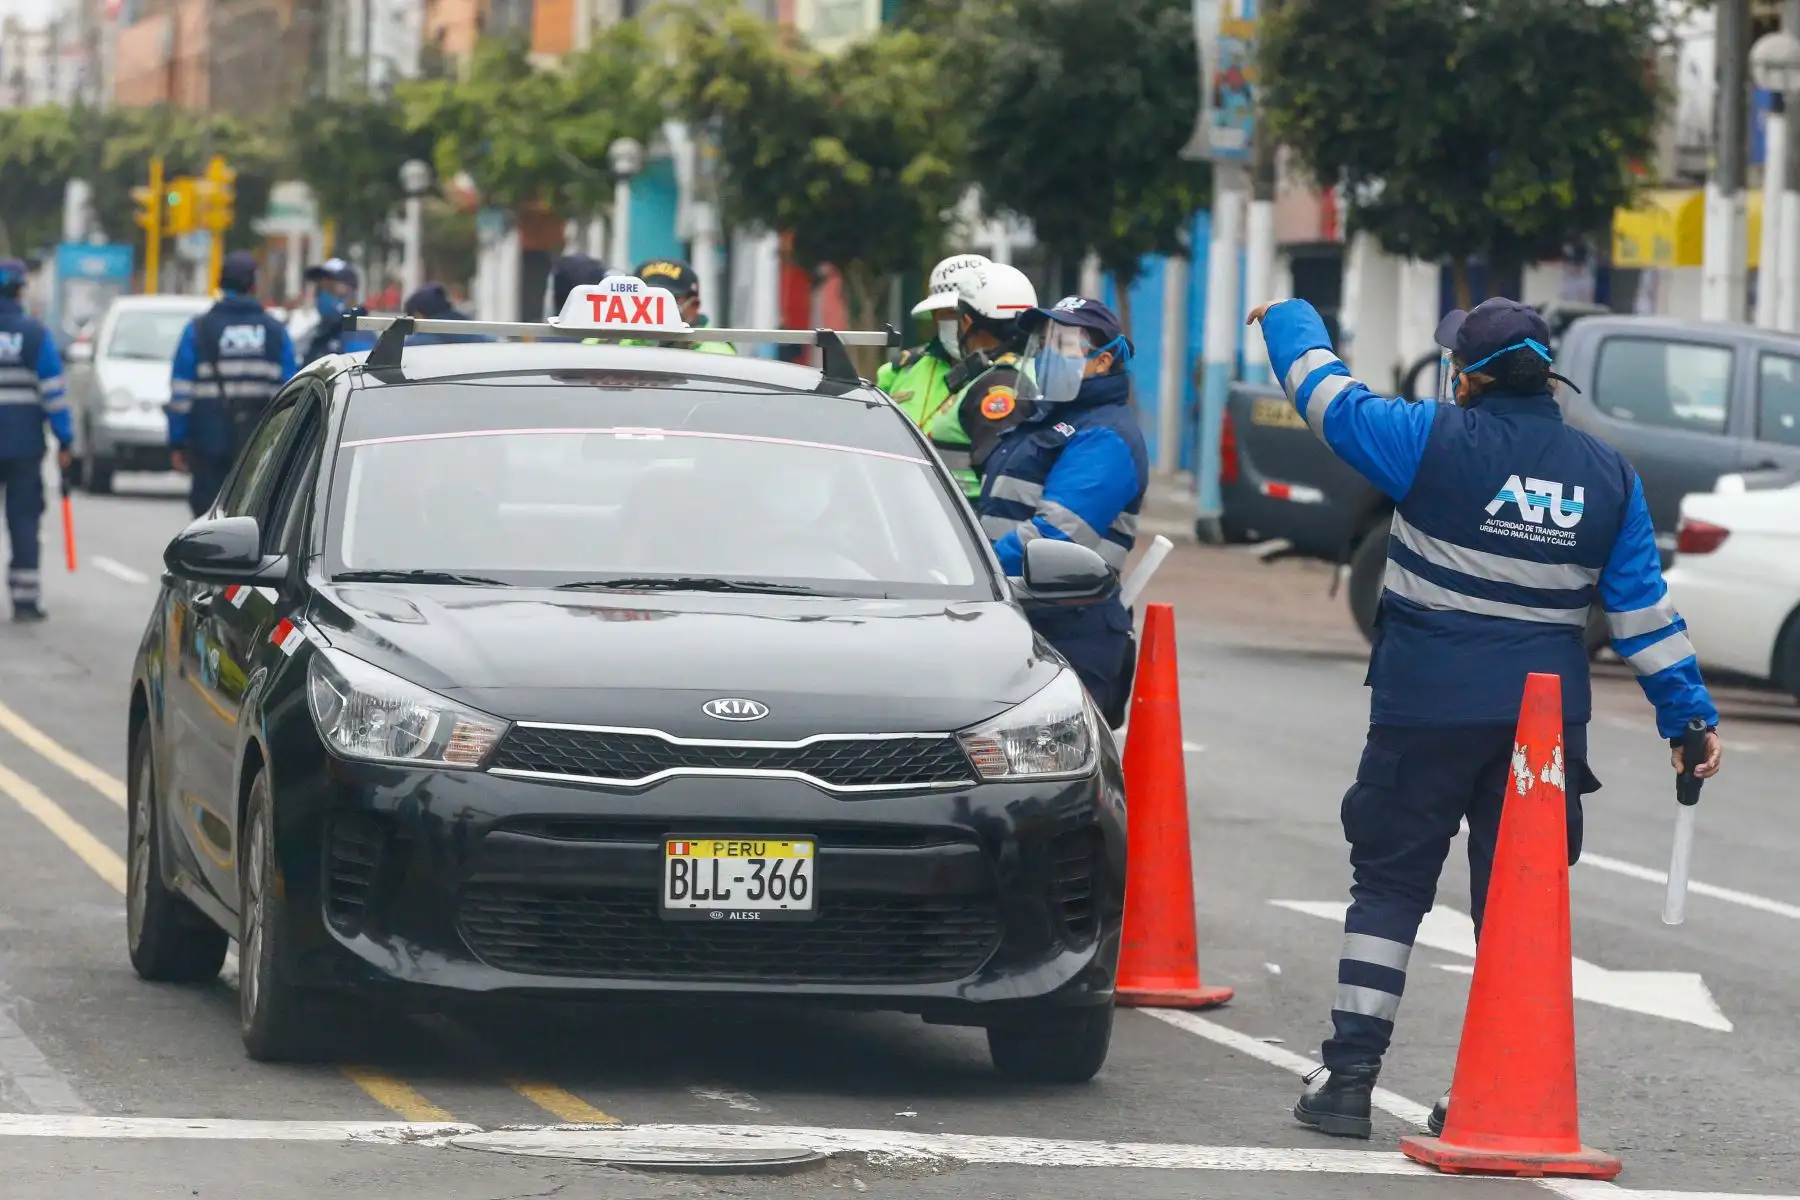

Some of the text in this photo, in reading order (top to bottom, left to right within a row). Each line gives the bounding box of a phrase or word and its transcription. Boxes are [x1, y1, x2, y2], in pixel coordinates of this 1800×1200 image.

[610, 283, 639, 293] LIBRE
[586, 294, 664, 325] TAXI
[1484, 474, 1585, 528] ATU
[1479, 524, 1510, 536] URBANO
[1510, 529, 1529, 540] PARA
[1529, 533, 1546, 543] LIMA
[1551, 537, 1577, 547] CALLAO
[1485, 518, 1576, 539] AUTORIDAD DE TRANSPORTE
[712, 699, 761, 716] KIA
[713, 842, 766, 856] PERU
[669, 858, 808, 901] BLL-366
[729, 911, 761, 920] ALESE
